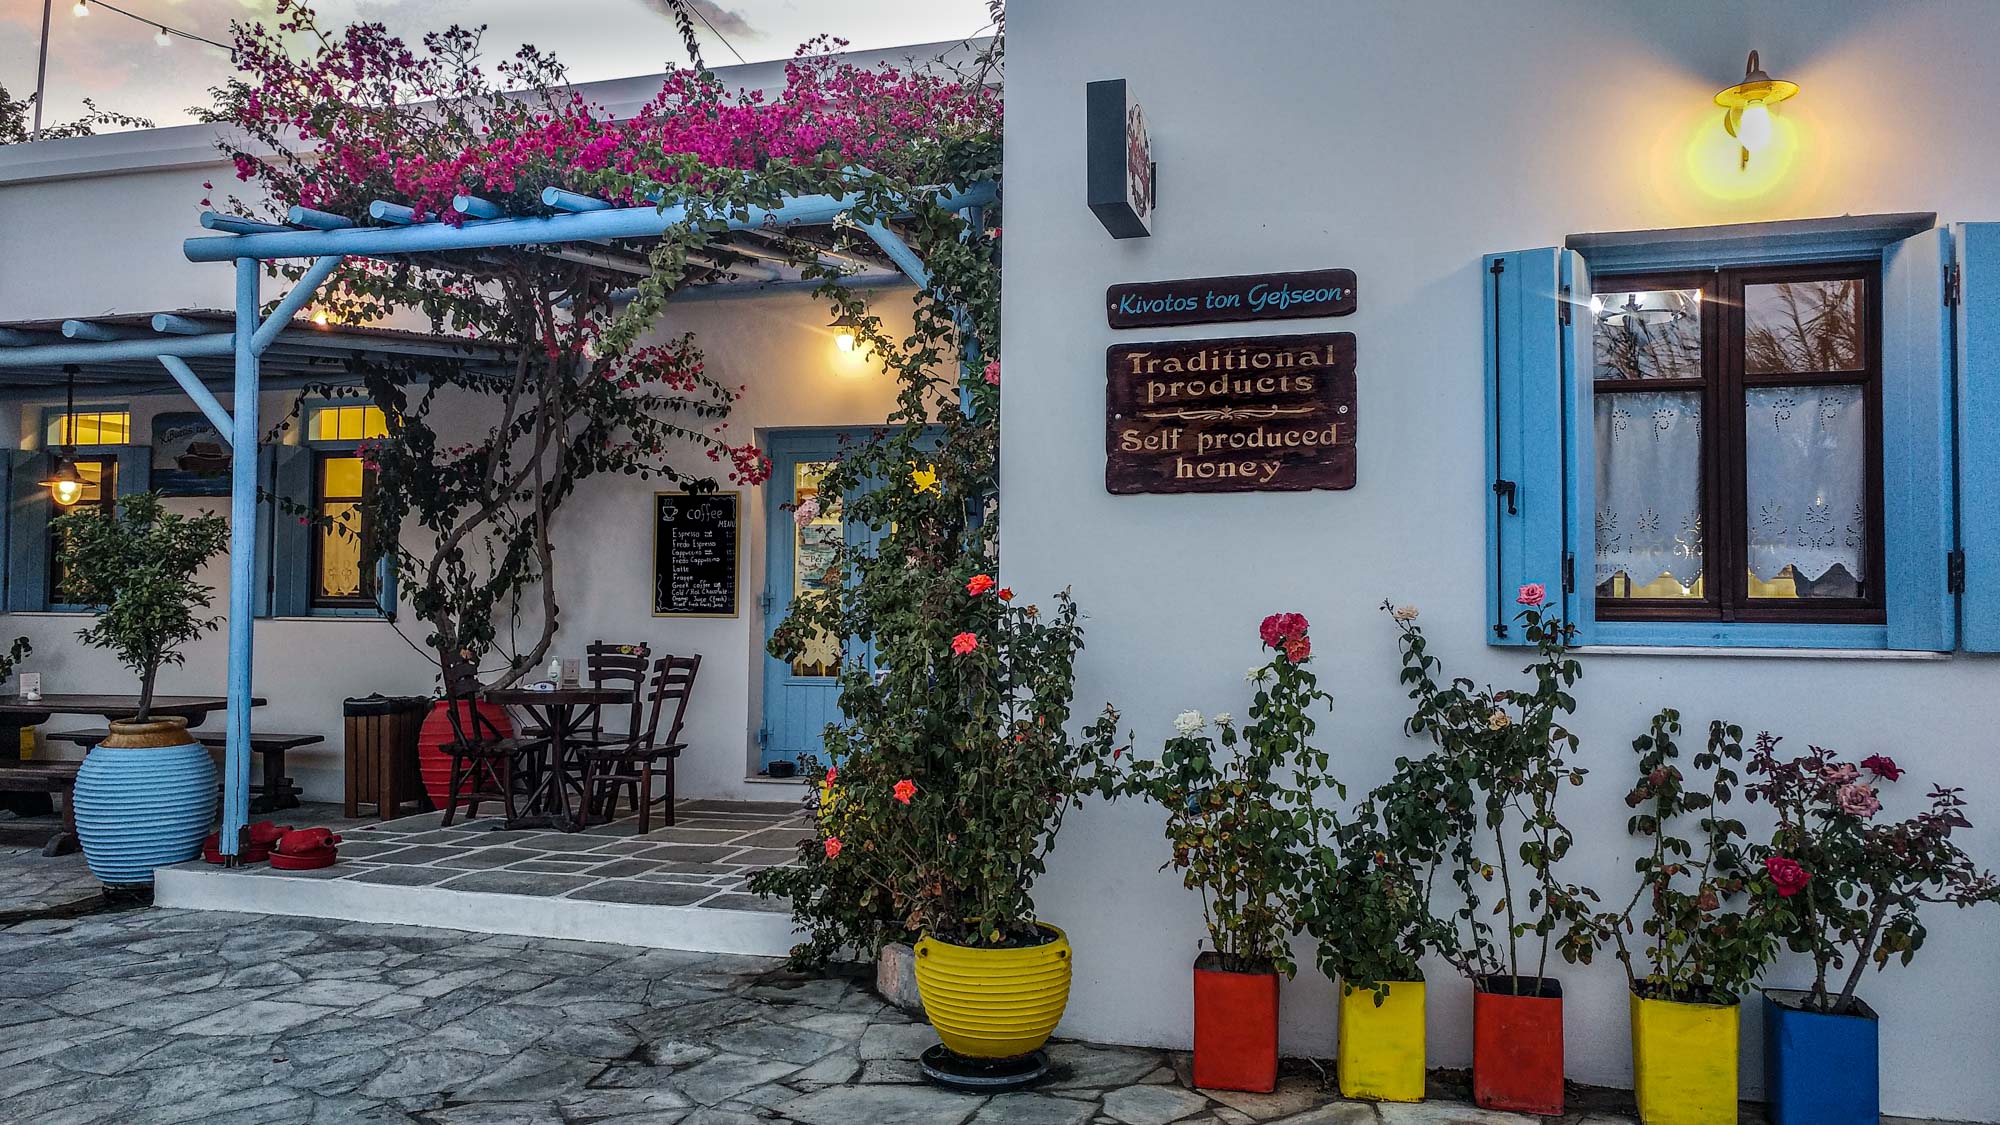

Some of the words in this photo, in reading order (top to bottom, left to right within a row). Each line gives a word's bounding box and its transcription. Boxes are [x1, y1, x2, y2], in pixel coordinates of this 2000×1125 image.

[1119, 293, 1198, 315] Kivotos
[1206, 290, 1241, 308] ton
[1248, 283, 1342, 313] Gefseon
[1126, 344, 1335, 375] Traditional
[1147, 373, 1314, 404] products
[1121, 427, 1183, 451] Self
[1198, 423, 1338, 456] produced
[1176, 456, 1281, 483] honey
[672, 527, 700, 540] Espresso
[672, 565, 689, 573] Latte
[672, 573, 694, 582] Frappe
[671, 581, 689, 589] Greek
[692, 579, 711, 589] coffee
